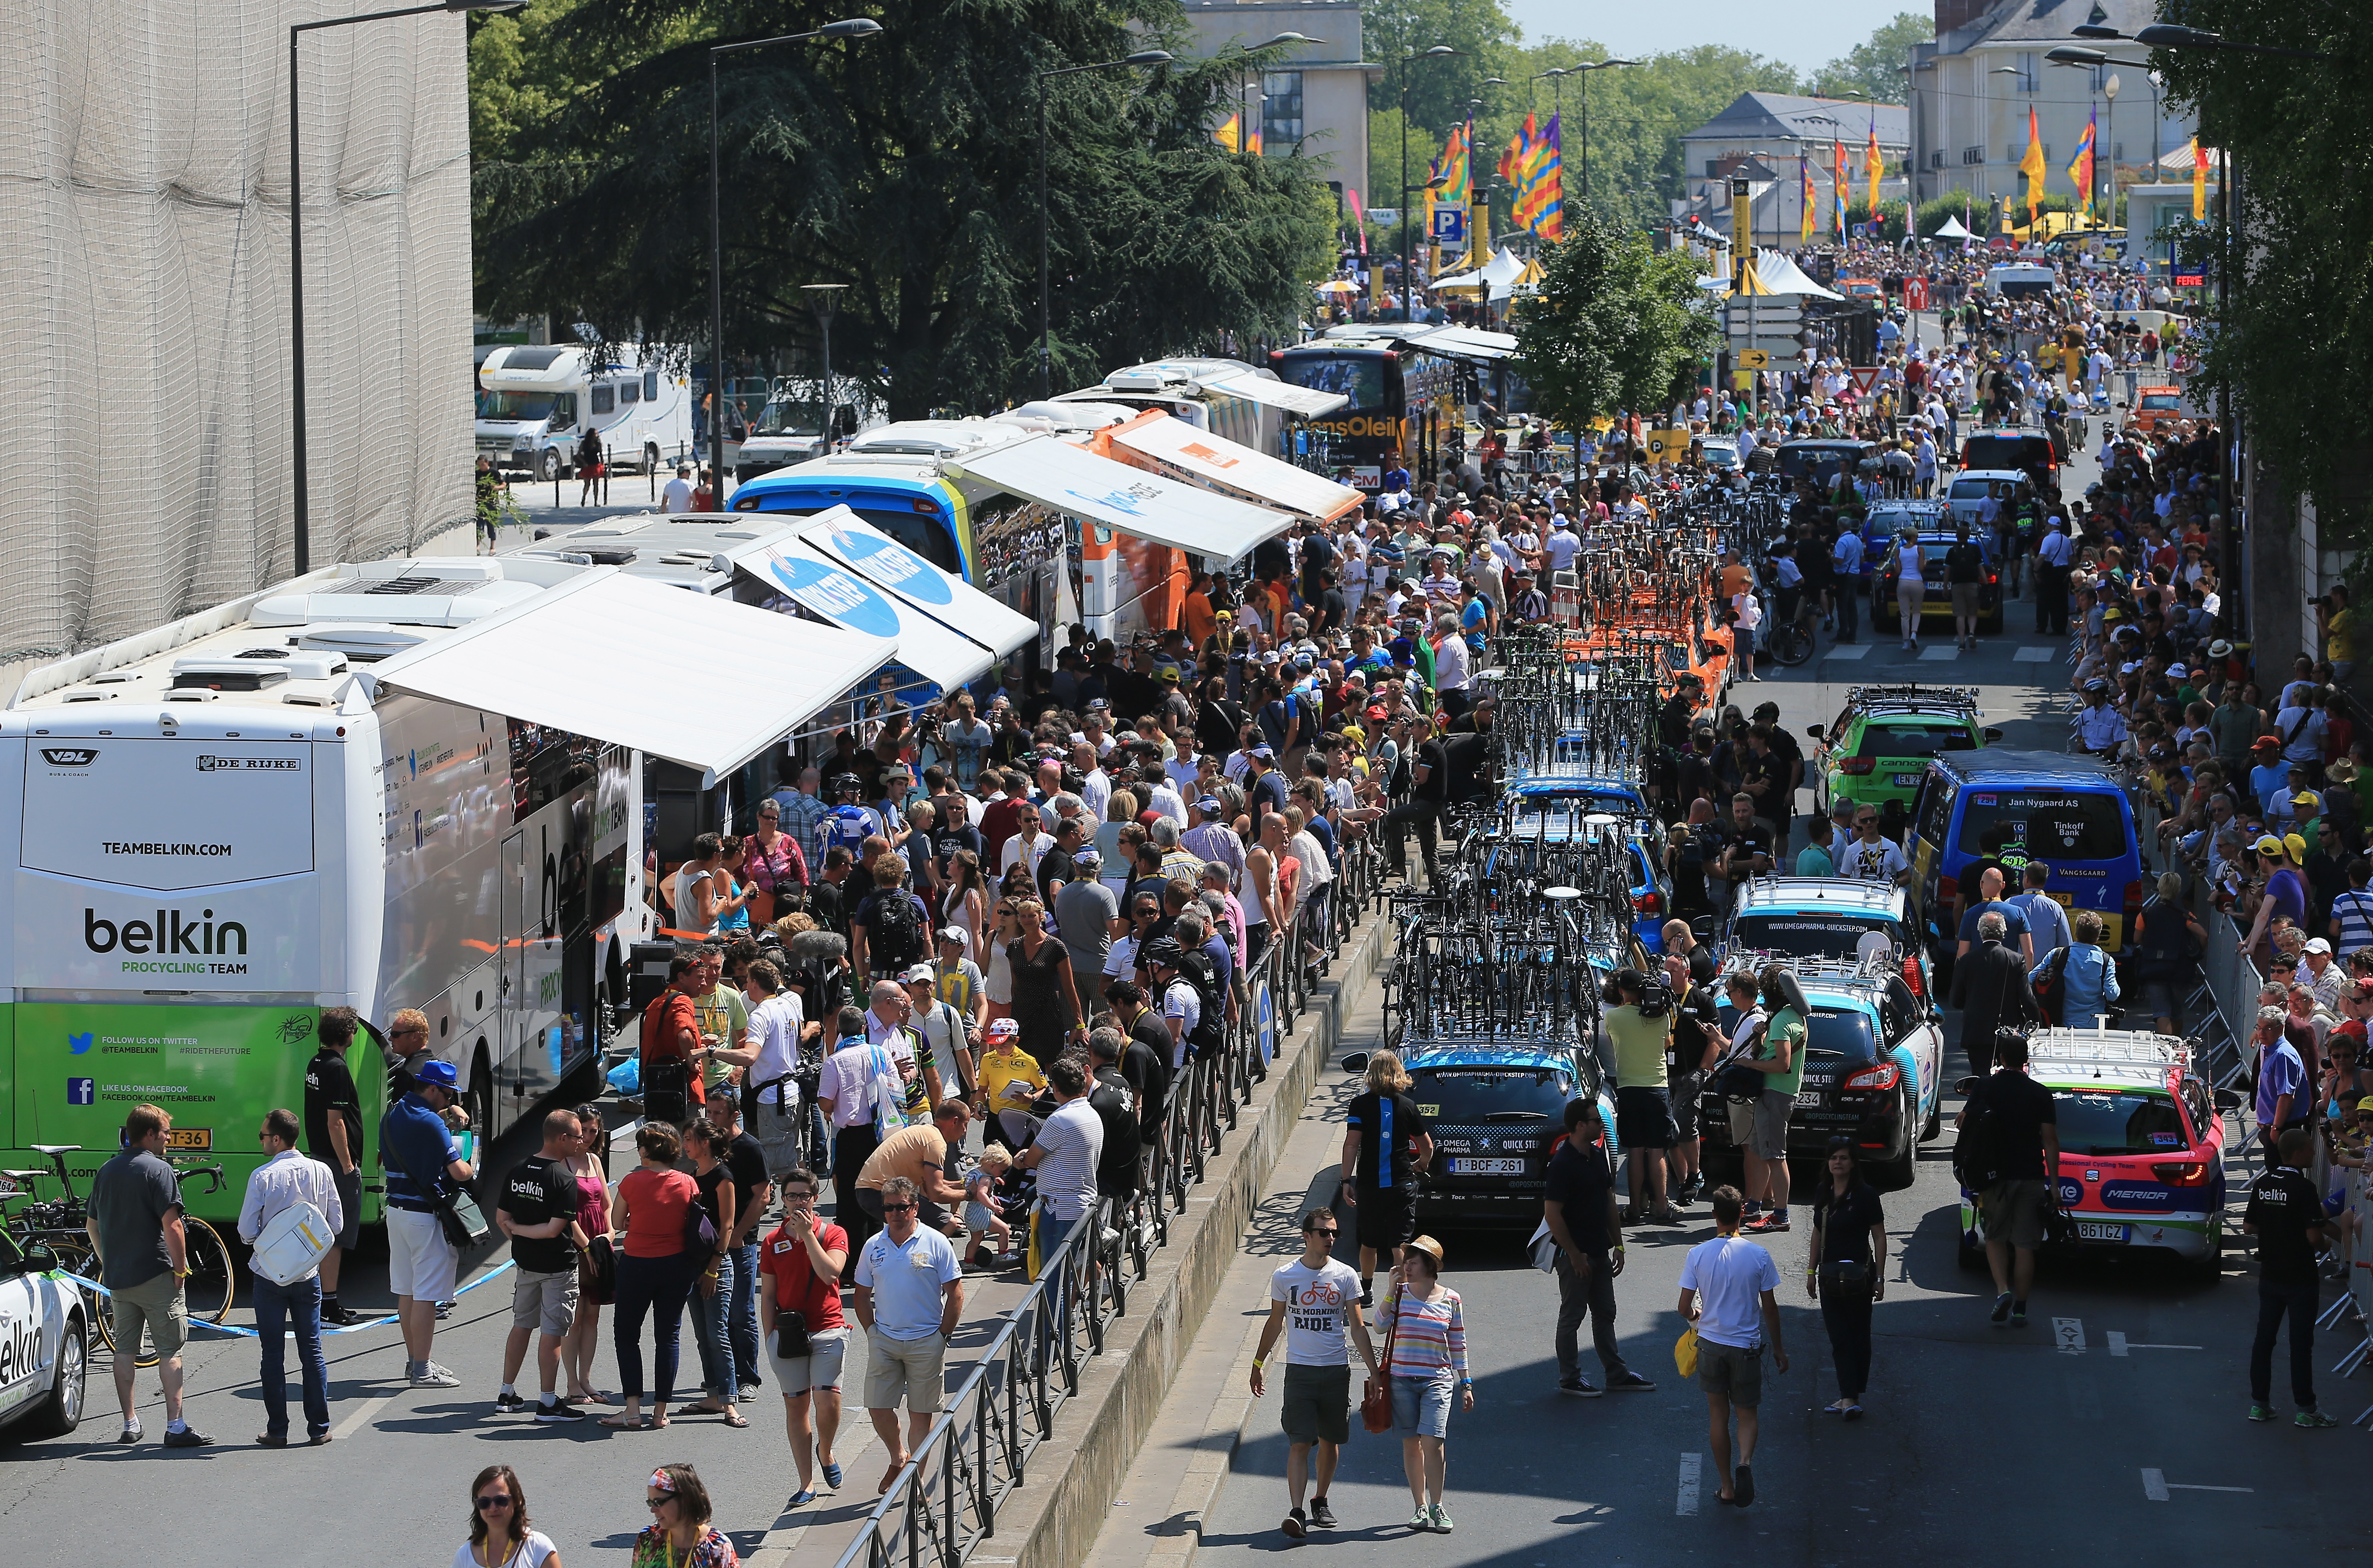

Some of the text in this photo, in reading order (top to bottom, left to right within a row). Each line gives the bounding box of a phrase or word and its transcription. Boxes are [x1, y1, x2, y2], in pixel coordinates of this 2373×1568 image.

[1440, 213, 1455, 233] P
[48, 751, 88, 763] VDL
[217, 759, 297, 768] DE RIJKE
[1899, 774, 1910, 784] EN
[2027, 799, 2064, 808] Nygaard
[611, 795, 627, 832] TEAM
[2054, 822, 2084, 830] Tinkoff
[102, 842, 232, 856] TEAMBELKIN.COM
[85, 908, 247, 955] belkin
[1768, 923, 1868, 933] WWW.OMEGAPHARMA-QUICKSTEP.COM
[122, 961, 247, 974] PROCYCLING TEAM
[102, 1046, 159, 1055] @TEAMBELKIN
[102, 1094, 215, 1102] FACEBOOK.COM/TEAMBELKIN
[1805, 1112, 1859, 1121] @OPOSCYCLINGTEAM
[2157, 1134, 2174, 1143] 343
[1503, 1140, 1540, 1149] QUICK STEP
[511, 1179, 543, 1197] belkin
[2107, 1190, 2168, 1200] MERIDA
[2259, 1188, 2287, 1201] belkin
[2080, 1224, 2122, 1239] 861GZ
[1290, 1285, 1300, 1306] I
[1288, 1305, 1301, 1314] THE
[1294, 1316, 1333, 1331] RIDE
[24, 1379, 41, 1397] TEAM
